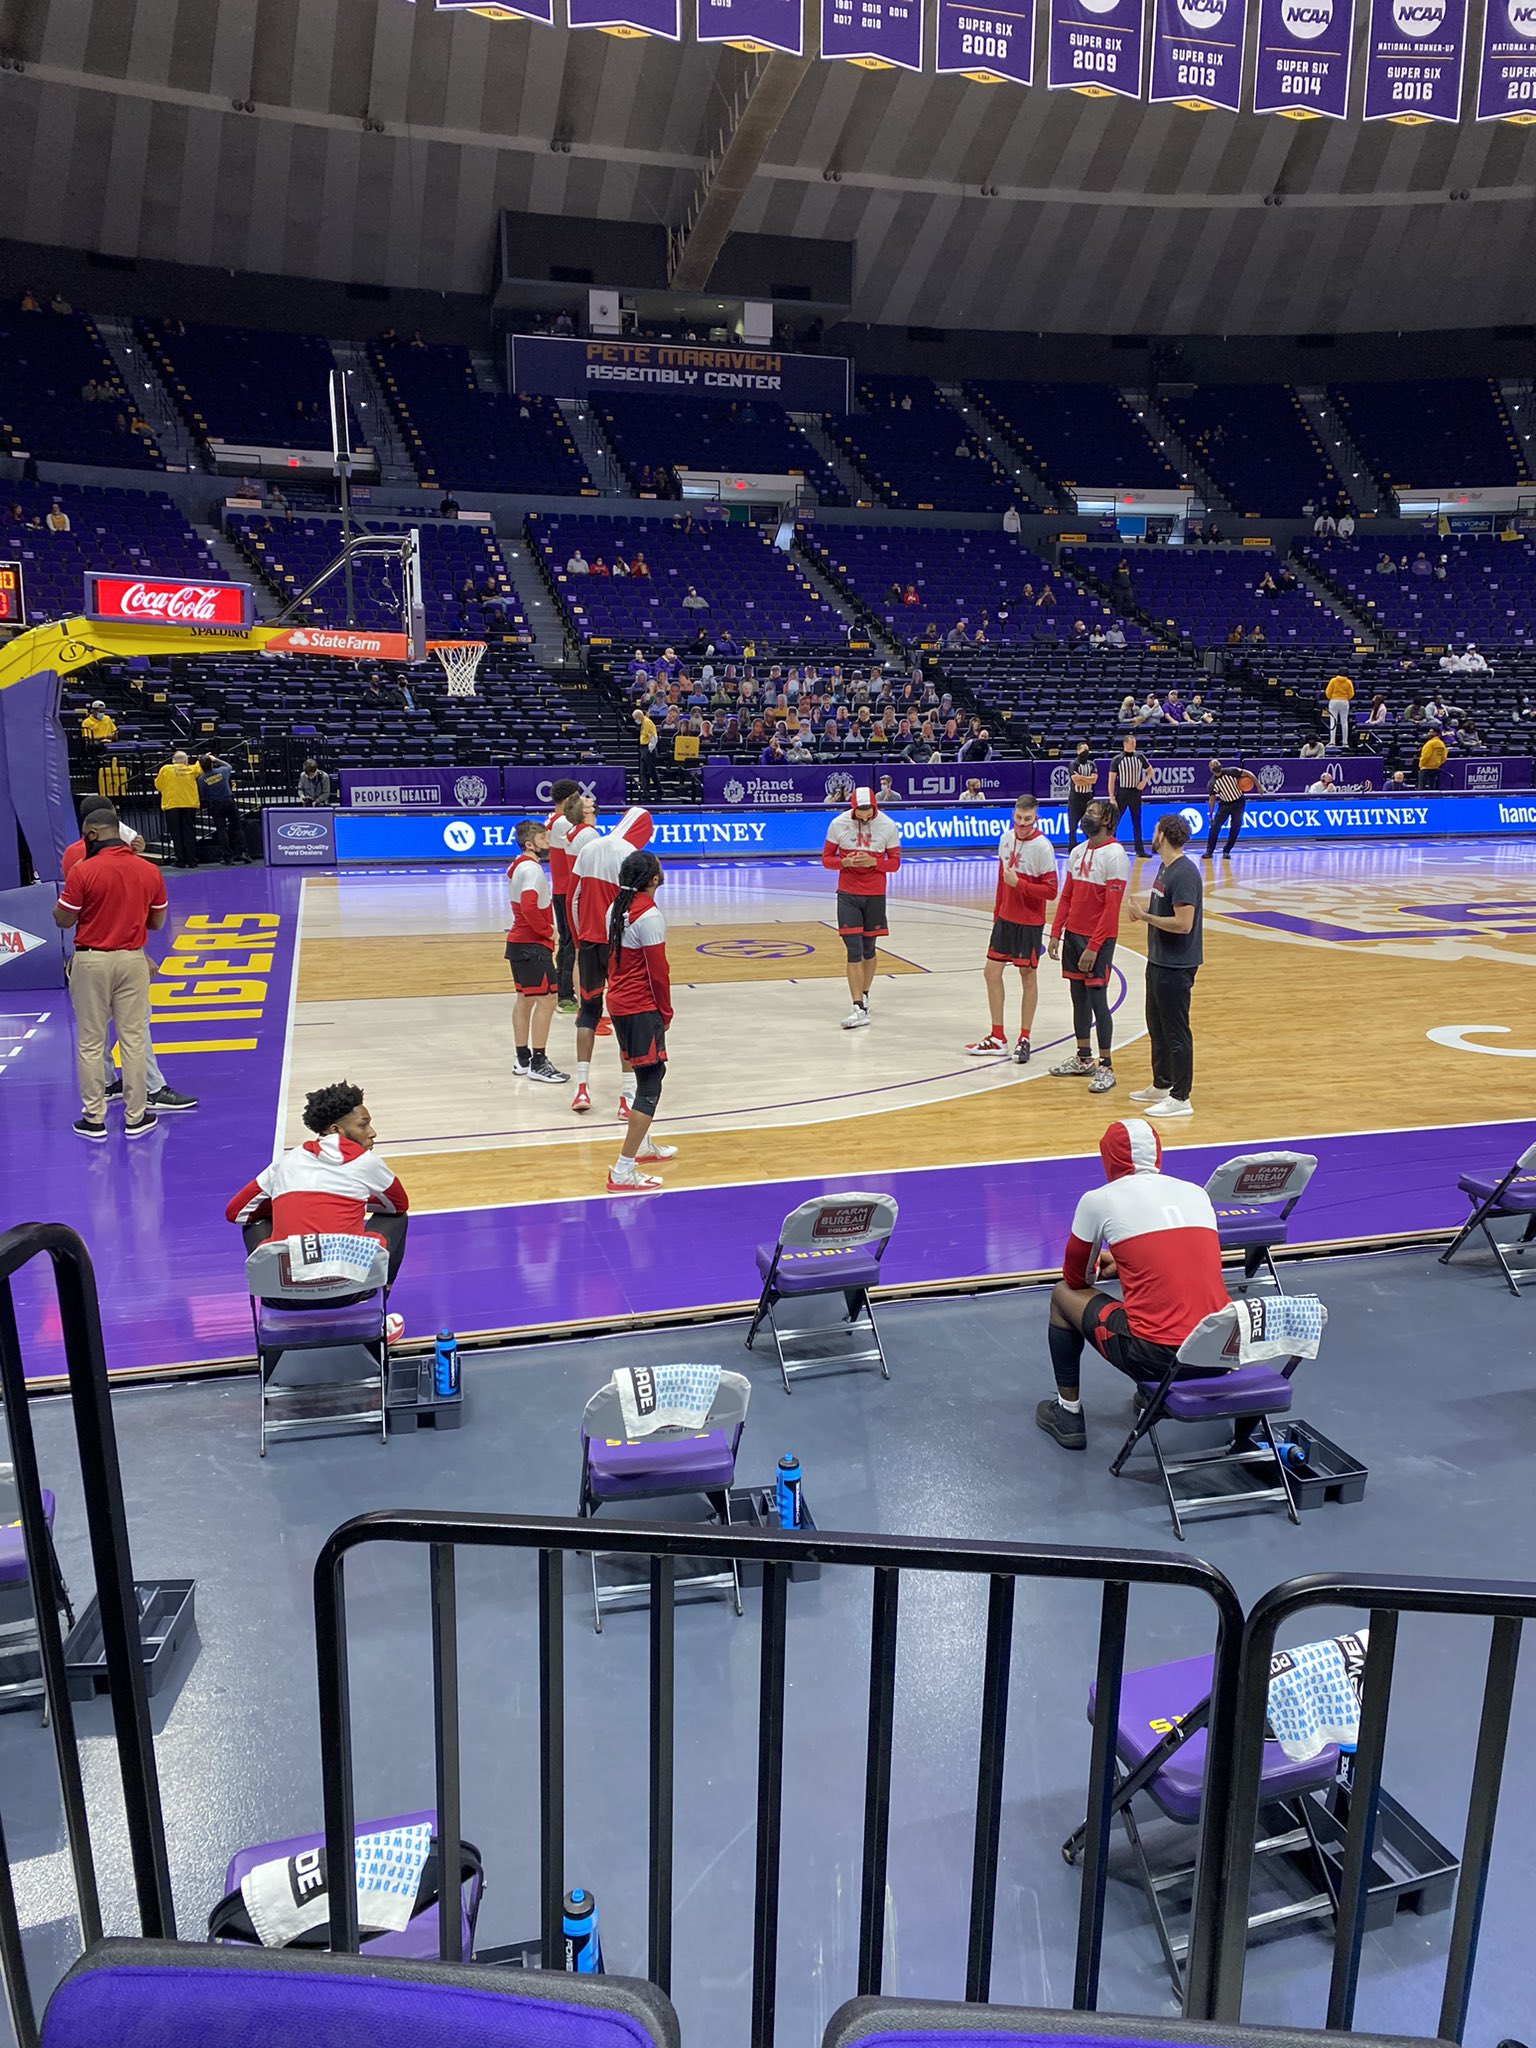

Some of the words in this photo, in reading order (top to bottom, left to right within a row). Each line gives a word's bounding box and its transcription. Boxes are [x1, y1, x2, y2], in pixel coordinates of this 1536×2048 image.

[863, 2, 882, 14] 2015
[889, 7, 909, 18] 2016
[1181, 0, 1225, 15] NCAA
[1398, 6, 1444, 22] NCAA
[1513, 7, 1536, 22] NC
[834, 14, 853, 26] 2017
[862, 17, 882, 29] 2018
[1286, 7, 1331, 25] NCAA
[958, 17, 992, 34] SUPER
[995, 22, 1013, 37] SIX
[962, 34, 1008, 58] 2008
[1069, 33, 1102, 49] SUPER
[1105, 37, 1122, 52] SIX
[1378, 43, 1412, 52] NATIONAL
[1414, 43, 1455, 53] RUNNER-UP
[1492, 43, 1528, 51] NATIONAL
[1073, 49, 1117, 73] 2009
[1172, 49, 1204, 64] SUPER
[1207, 52, 1224, 66] SIX
[1276, 60, 1309, 74] SUPER
[1311, 62, 1329, 75] SIX
[1387, 67, 1421, 79] SUPER
[1423, 67, 1442, 80] SIX
[1501, 66, 1536, 79] SUPER
[1178, 65, 1216, 87] 2013
[1281, 75, 1321, 96] 2014
[1392, 82, 1434, 100] 2016
[587, 344, 650, 364] PETE
[658, 349, 783, 372] MARAVICH
[586, 365, 699, 384] ASSEMBLY
[705, 371, 782, 390] CENTER
[121, 583, 221, 619] Coca-Cola
[191, 627, 249, 640] SPALDING
[1053, 769, 1069, 786] SEC
[1476, 766, 1499, 775] FARM
[747, 778, 794, 793] planet
[1468, 774, 1499, 783] BUREAU
[536, 779, 597, 802] CX
[909, 776, 956, 797] LSU
[1151, 785, 1185, 794] MARKETS
[354, 788, 398, 803] PEOPLES
[402, 786, 439, 802] HEALTH
[753, 791, 803, 803] fitness
[1208, 809, 1321, 829] NCOCK
[1324, 807, 1429, 827] WHITNEY
[287, 824, 318, 837] Ford
[1243, 1173, 1286, 1183] BUREAU
[1257, 1167, 1288, 1175] FARM
[836, 1207, 869, 1217] FARM
[820, 1214, 868, 1226] BUREAU
[828, 1225, 866, 1234] INSURANCE
